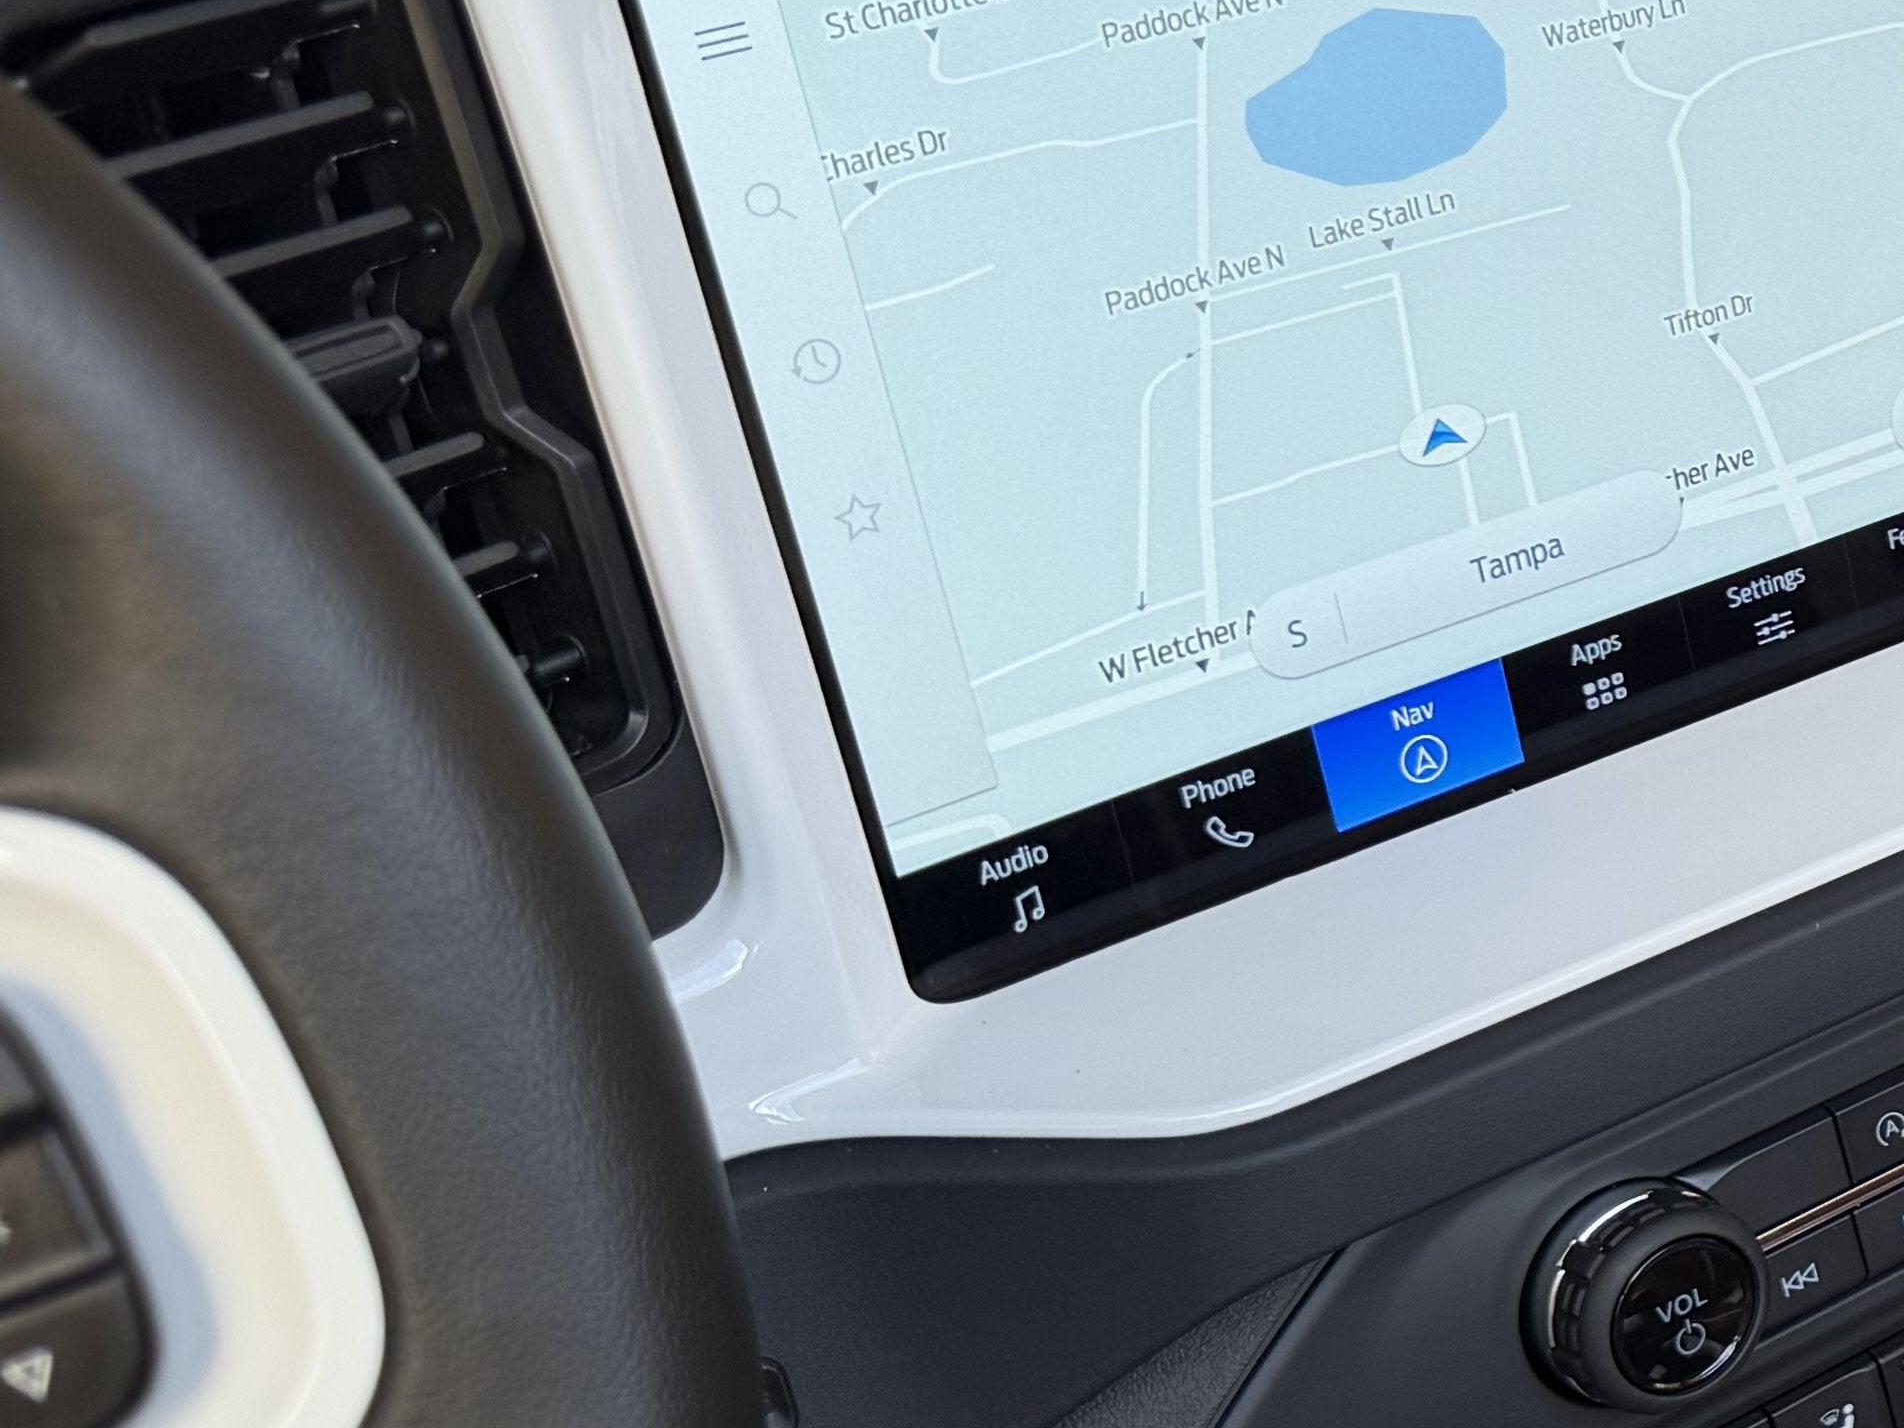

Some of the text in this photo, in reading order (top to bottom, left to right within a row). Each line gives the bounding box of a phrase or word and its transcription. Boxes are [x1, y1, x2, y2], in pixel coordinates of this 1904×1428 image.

[825, 10, 856, 41] St
[1101, 1, 1209, 48] Paddock
[1542, 3, 1652, 49] Waterbury
[917, 130, 947, 156] Dr
[1309, 189, 1455, 249] Lake Stall Ln
[1105, 245, 1285, 315] Paddock Ave N
[1663, 293, 1754, 339] Tifton Dr
[1665, 449, 1754, 490] her Ave
[1470, 534, 1564, 585] Tampa
[1727, 566, 1805, 610] Settings
[1098, 653, 1126, 683] W
[1132, 621, 1237, 673] Fletcher
[1288, 620, 1308, 648] S
[1570, 633, 1621, 668] Apps
[1391, 701, 1435, 731] Nav
[1182, 765, 1255, 809] Phone
[979, 840, 1048, 886] Audio
[1656, 1288, 1708, 1324] VOL
